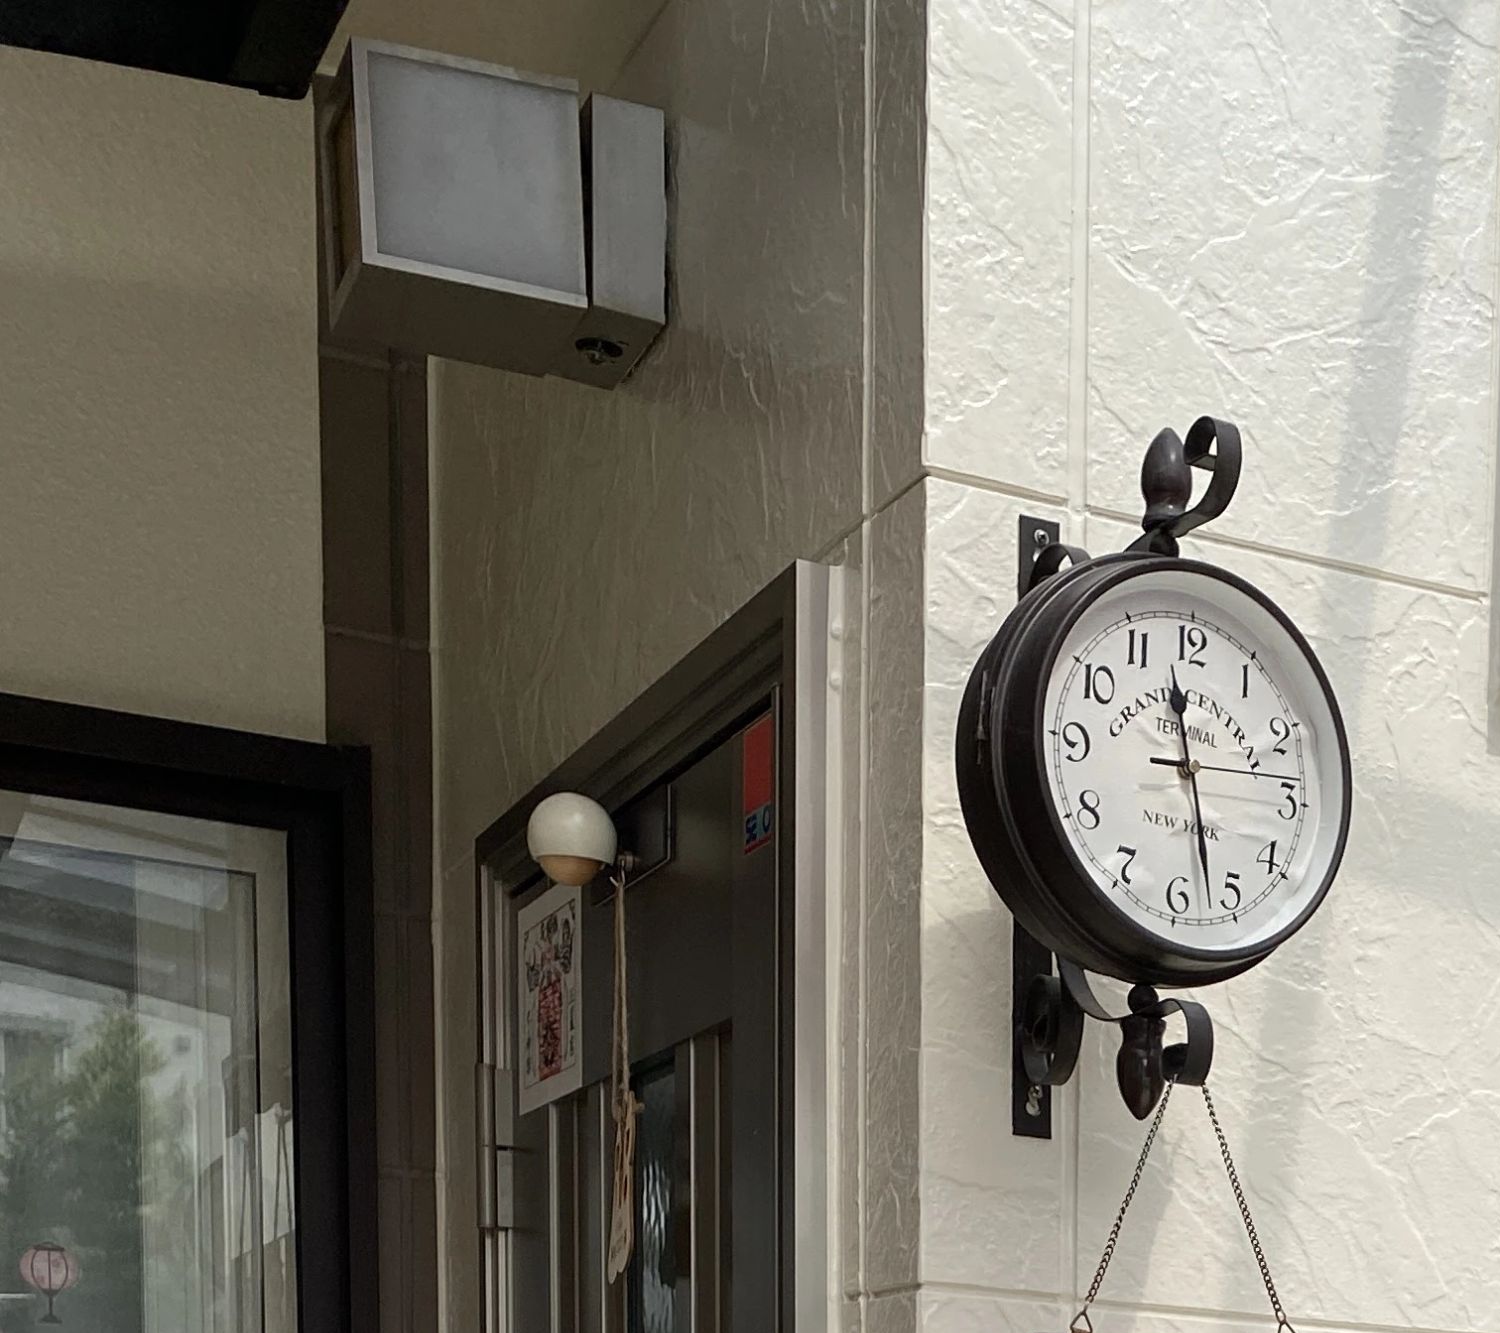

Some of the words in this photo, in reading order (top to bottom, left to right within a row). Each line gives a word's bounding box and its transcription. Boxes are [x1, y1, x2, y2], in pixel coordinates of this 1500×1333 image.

[1127, 628, 1149, 669] 11
[1178, 624, 1208, 668] 12
[1083, 663, 1116, 705] 10
[1241, 664, 1250, 699] 1
[1062, 721, 1091, 763] 9
[1109, 686, 1173, 738] GRAND
[1184, 688, 1262, 780] CENTRAL
[1155, 716, 1219, 749] TERMINAL
[1269, 716, 1291, 756] 2
[1076, 789, 1101, 830] 8
[1277, 781, 1297, 821] 3
[1142, 809, 1178, 829] NEW
[1182, 818, 1220, 842] YORK
[1117, 845, 1137, 884] 7
[1256, 839, 1281, 875] 4
[1166, 876, 1190, 915] 6
[1220, 871, 1241, 911] 5
